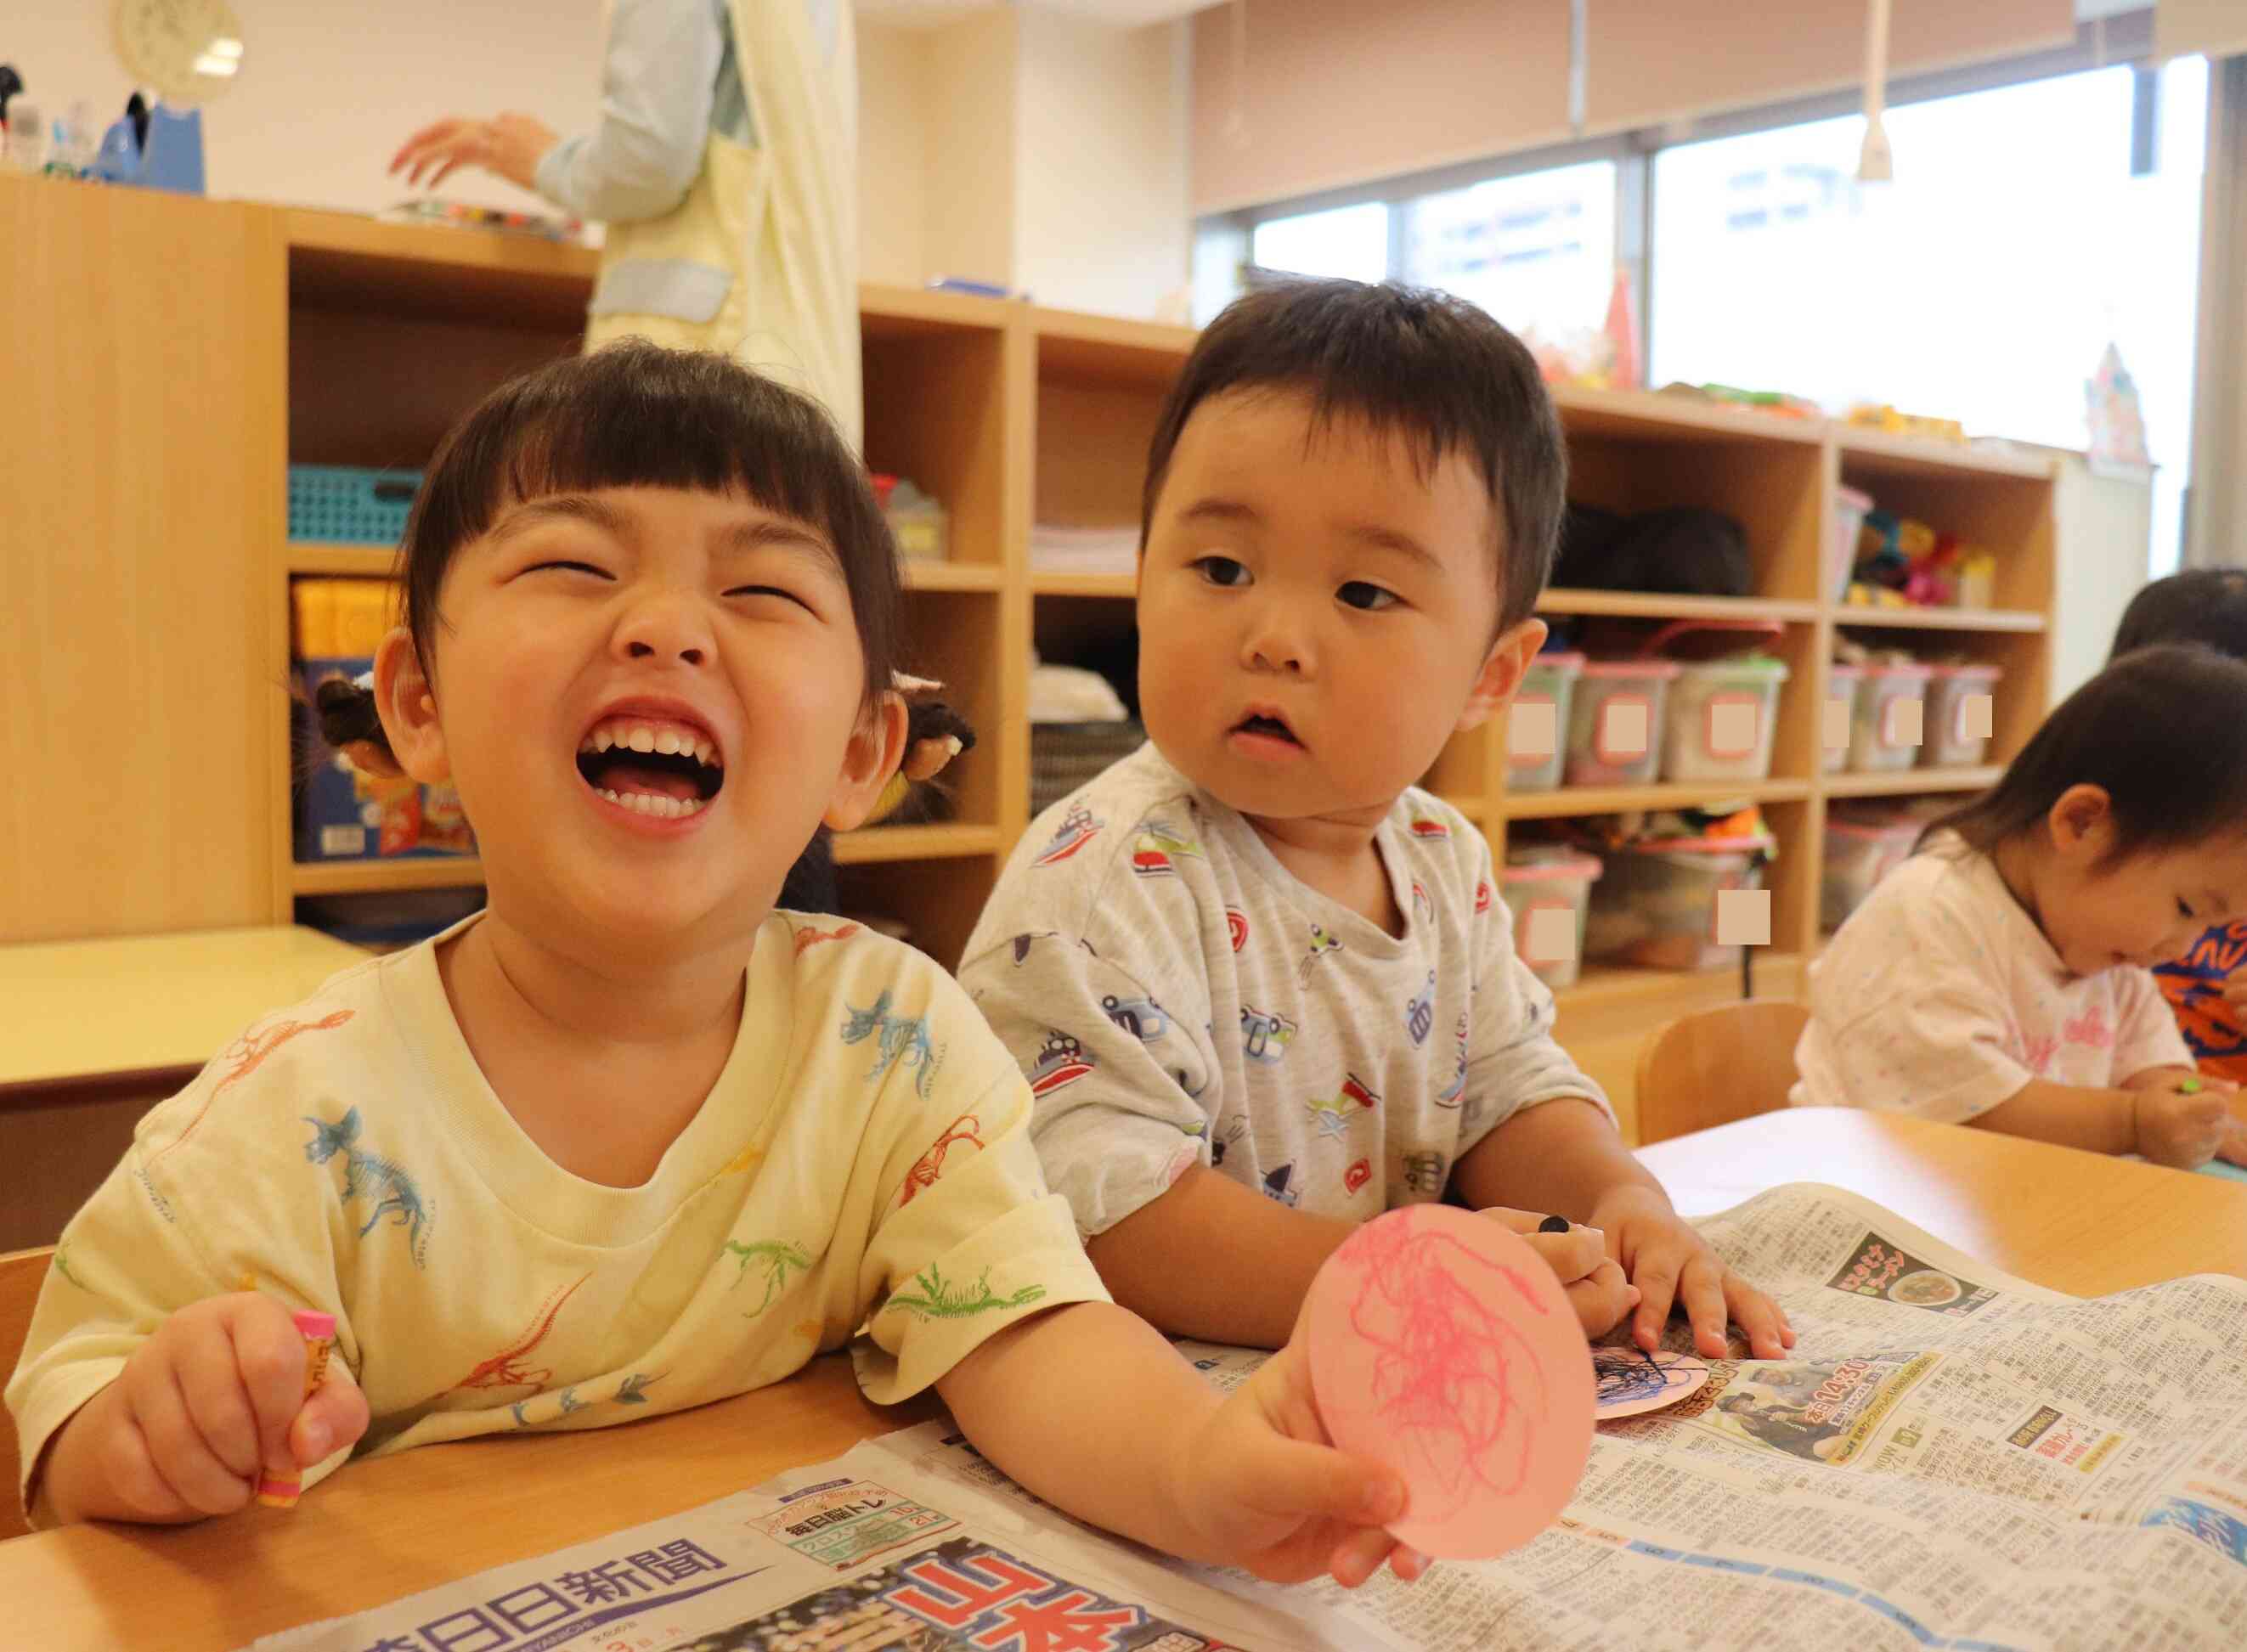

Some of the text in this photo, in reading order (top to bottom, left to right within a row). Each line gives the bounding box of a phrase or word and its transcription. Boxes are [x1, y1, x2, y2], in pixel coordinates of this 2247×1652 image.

[785, 1498, 886, 1536] 毎日脳トレ
